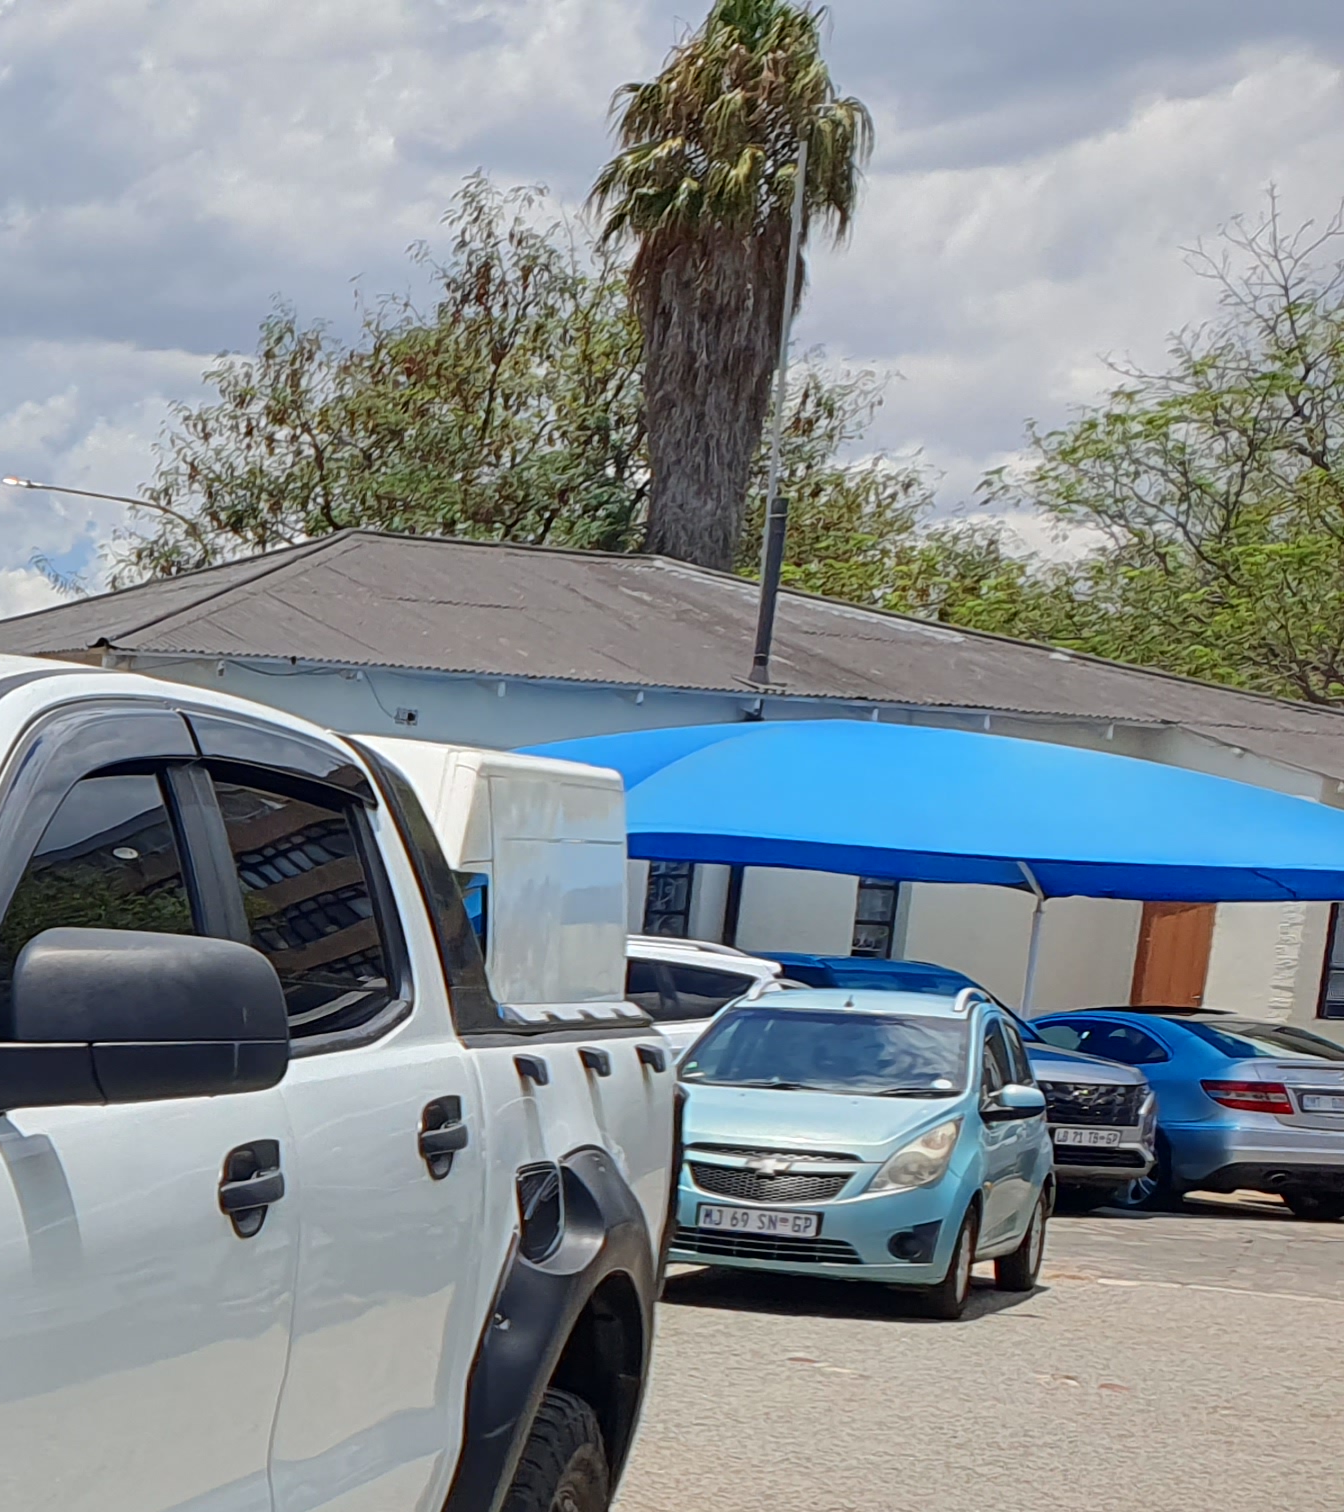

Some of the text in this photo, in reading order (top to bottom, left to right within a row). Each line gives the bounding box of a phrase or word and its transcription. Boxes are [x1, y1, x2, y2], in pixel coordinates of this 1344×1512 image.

[730, 1211, 750, 1228] 69
[757, 1213, 778, 1232] SN
[791, 1215, 813, 1234] GP
